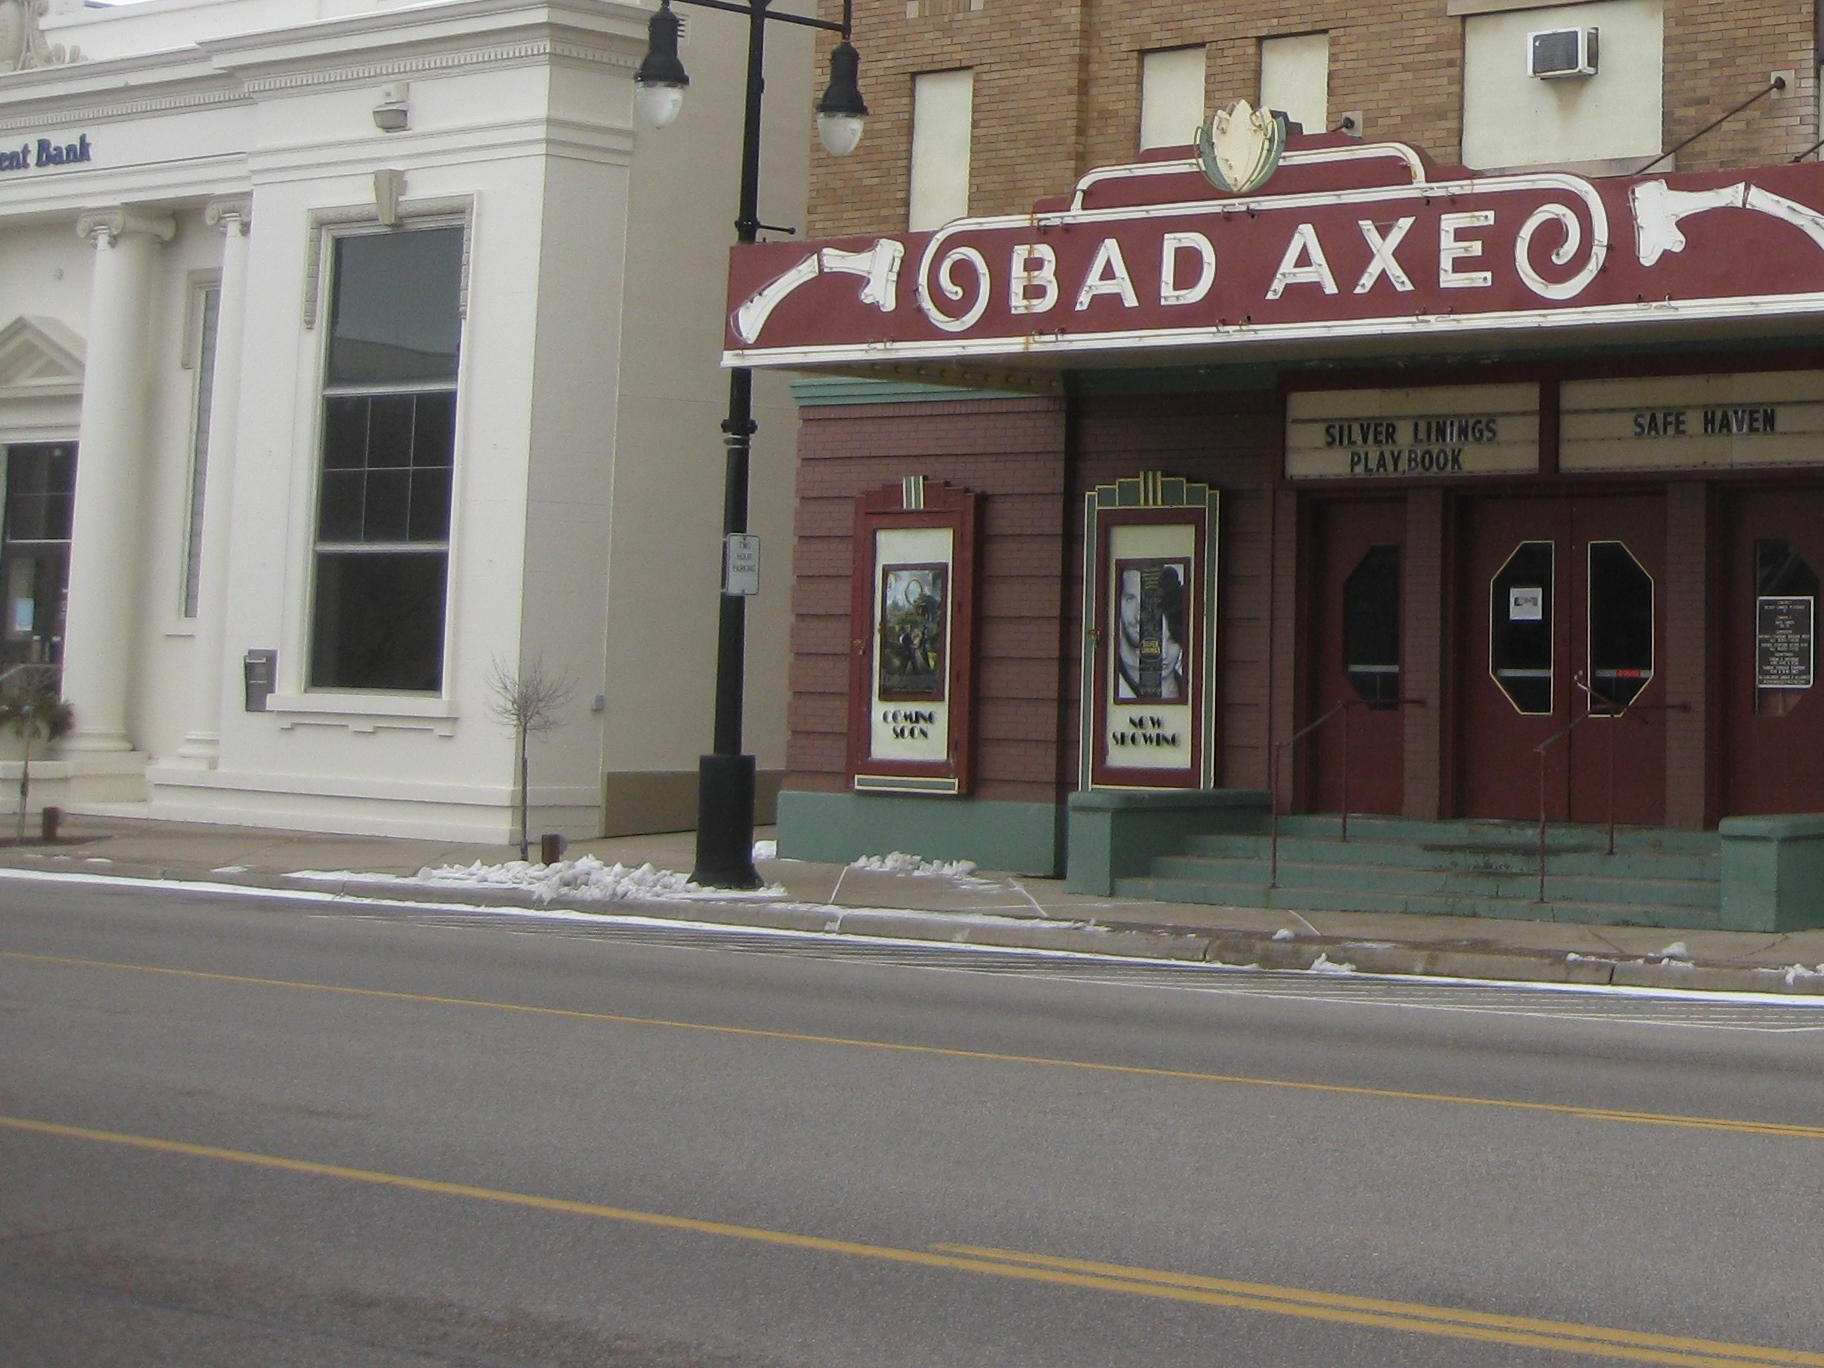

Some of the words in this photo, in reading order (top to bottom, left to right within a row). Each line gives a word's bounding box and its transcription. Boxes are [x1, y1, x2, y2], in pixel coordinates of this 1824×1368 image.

[35, 133, 92, 167] Bank
[1009, 231, 1217, 315] BAD
[1264, 210, 1496, 301] AXE
[1325, 422, 1397, 447] SILVER
[1413, 418, 1497, 444] LININGS
[1633, 411, 1687, 436] SAFE
[1703, 408, 1776, 434] HAVEN
[882, 710, 939, 725] COMING
[1128, 715, 1166, 730] NOW
[892, 725, 929, 740] SOON
[1111, 731, 1182, 746] SHOWING
